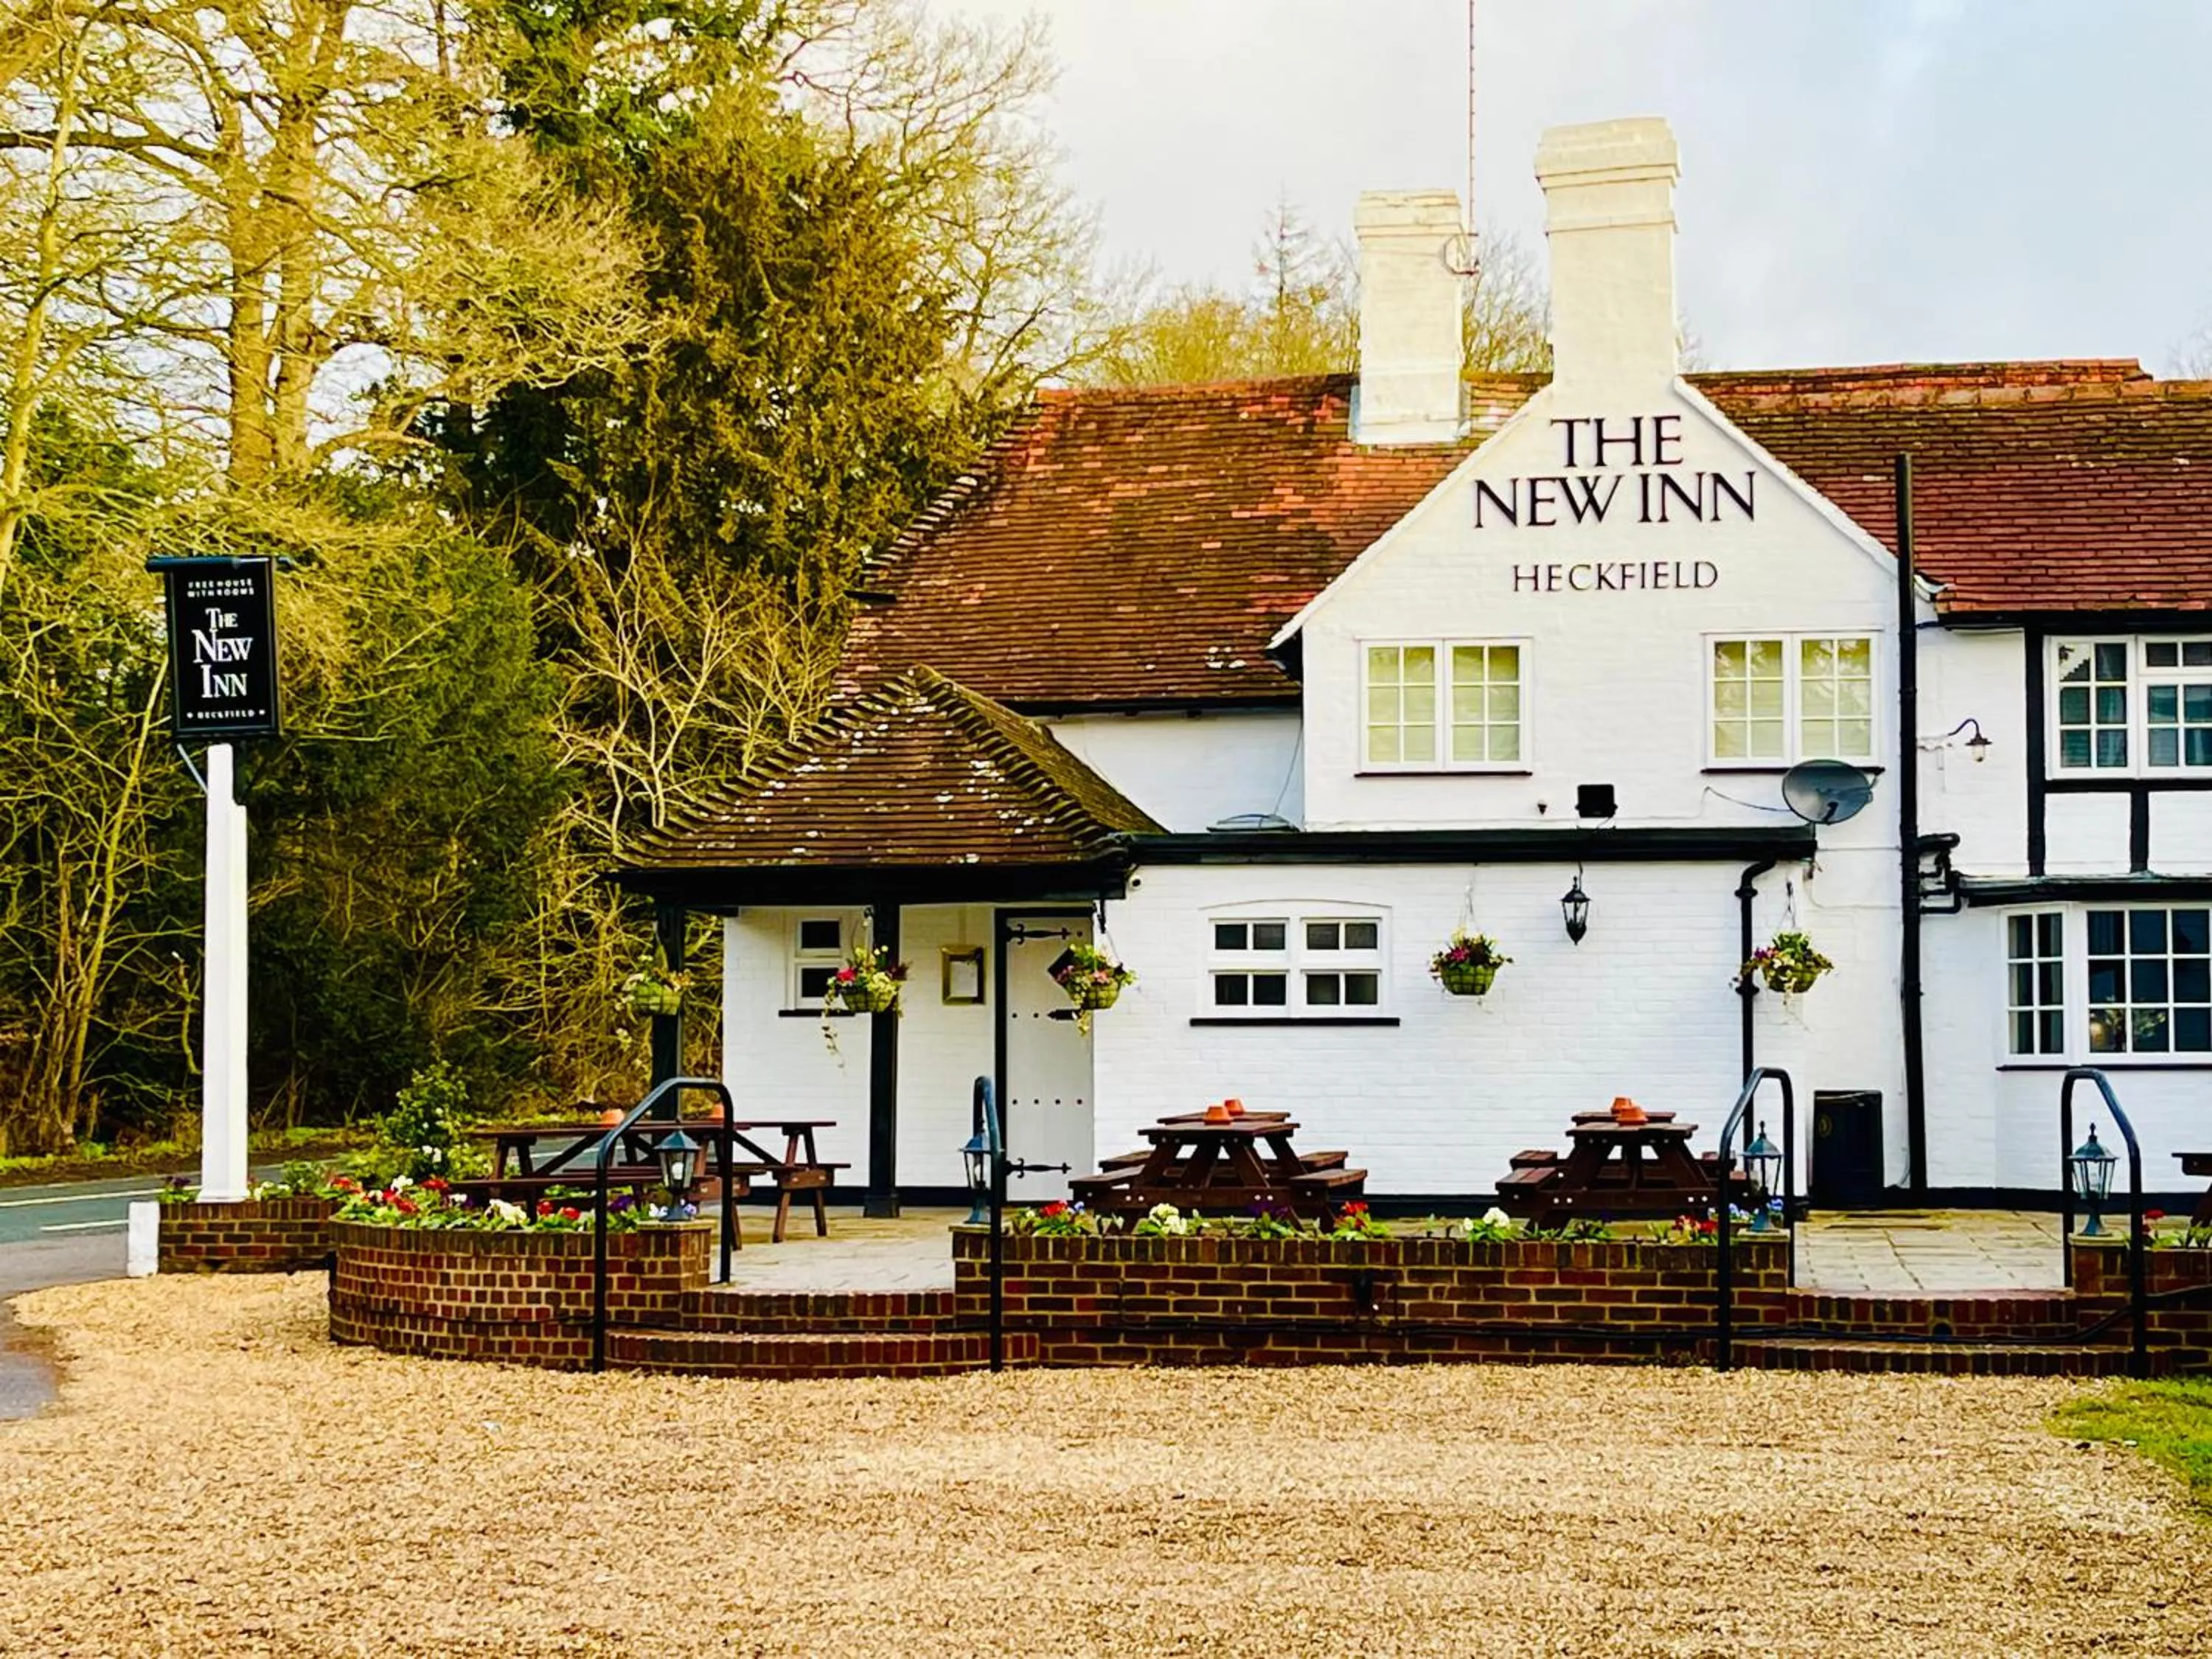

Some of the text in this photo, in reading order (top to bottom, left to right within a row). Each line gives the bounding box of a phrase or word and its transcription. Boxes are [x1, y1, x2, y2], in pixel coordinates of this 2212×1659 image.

[1550, 415, 1683, 468] THE
[1474, 470, 1756, 529] NEW INN
[1512, 561, 1719, 592] HECKFIELD
[205, 607, 238, 629] THE
[191, 628, 253, 664] NEW
[200, 664, 248, 698] INN
